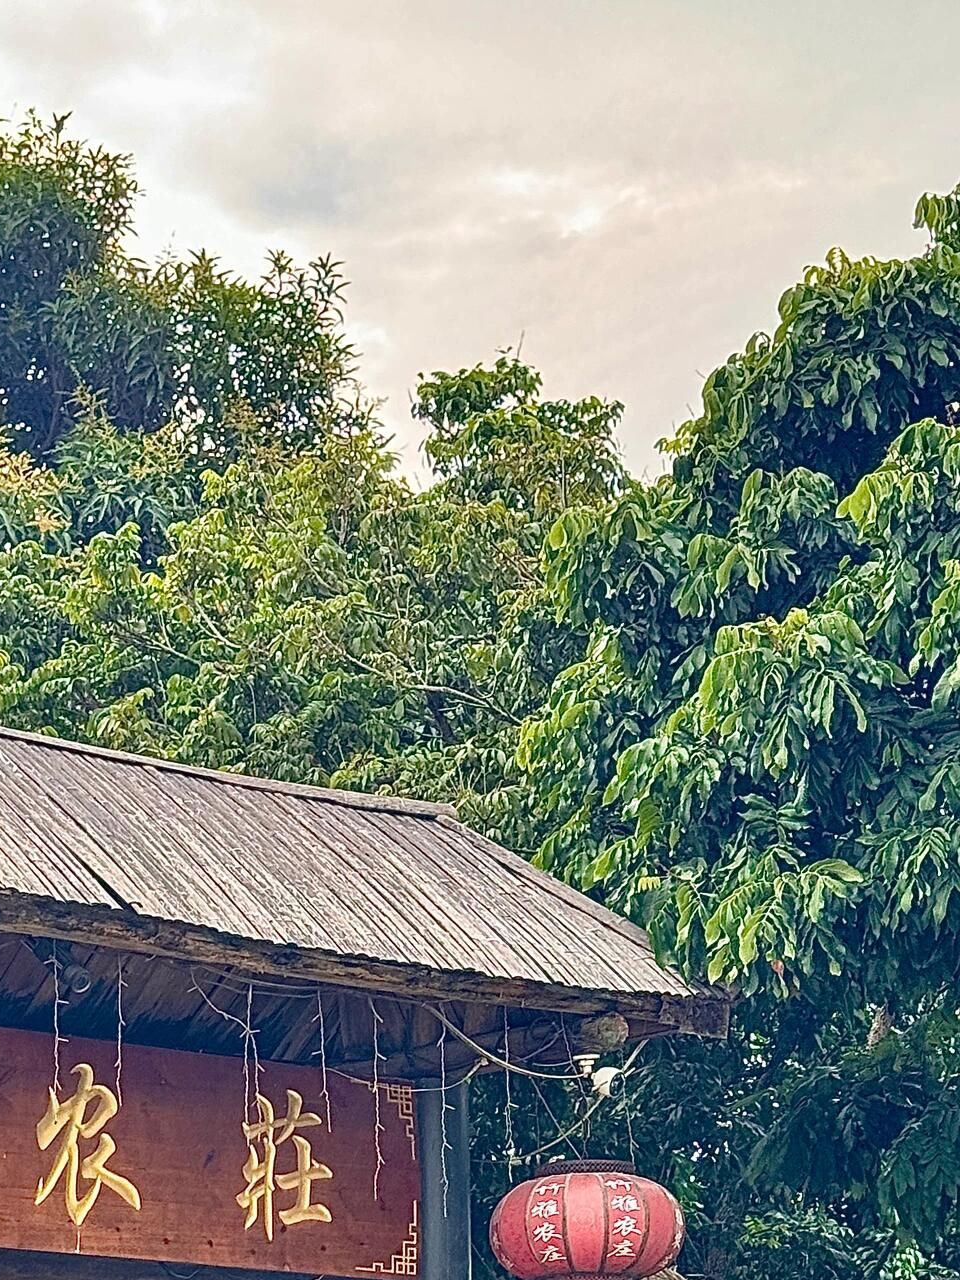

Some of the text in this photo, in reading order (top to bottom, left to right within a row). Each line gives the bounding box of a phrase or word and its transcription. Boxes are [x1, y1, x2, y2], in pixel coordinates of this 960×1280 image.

[530, 1182, 568, 1263] 竹雅农庄
[605, 1178, 643, 1258] 竹雅农庄
